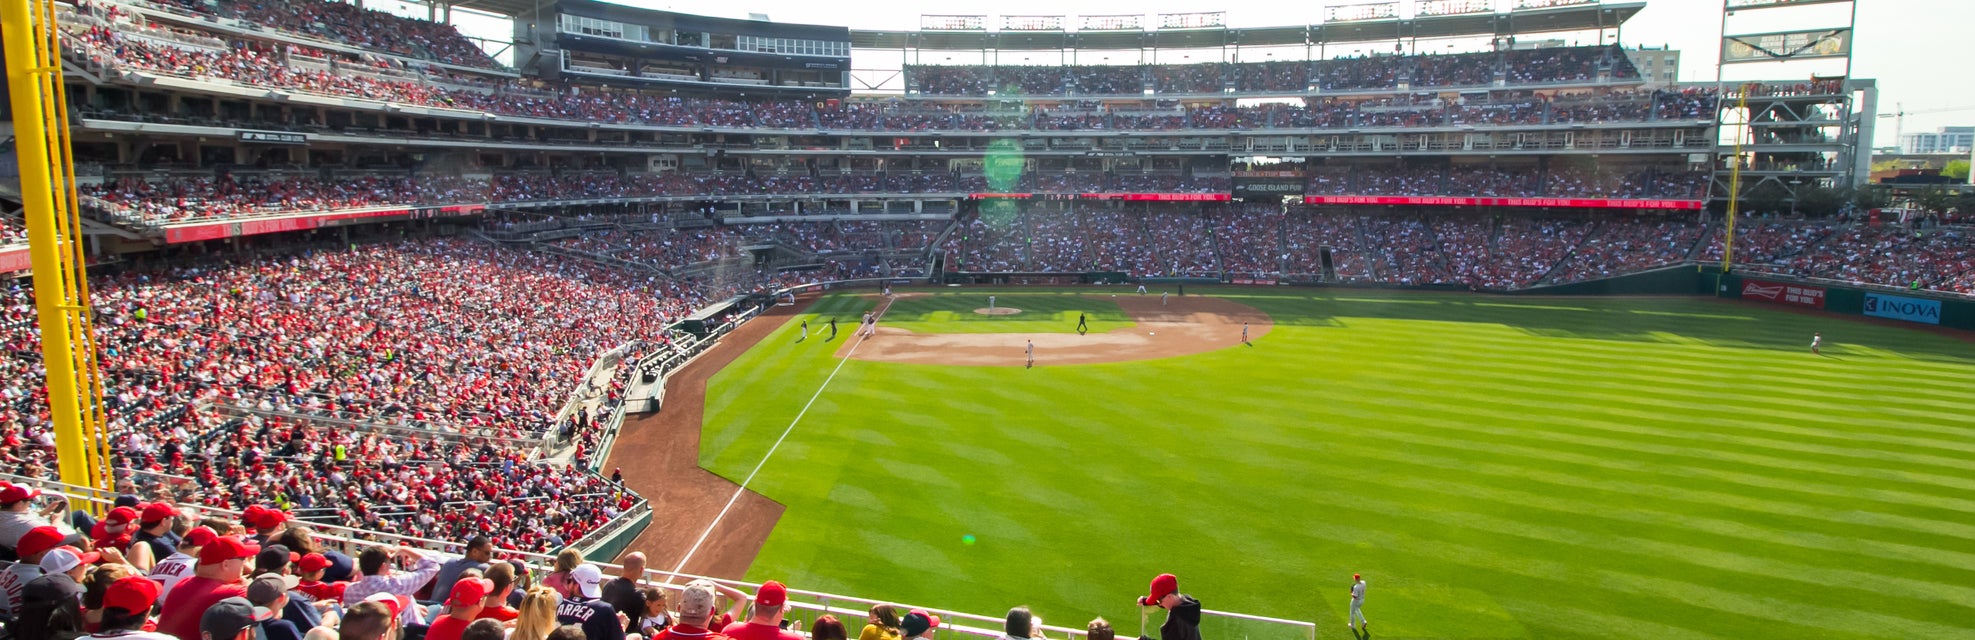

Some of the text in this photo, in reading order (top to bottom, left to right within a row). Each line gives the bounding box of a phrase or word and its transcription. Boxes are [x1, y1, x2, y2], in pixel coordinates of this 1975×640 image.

[1785, 294, 1799, 302] FOR
[1787, 286, 1802, 295] THIS
[1802, 288, 1823, 298] BUD'S
[1882, 300, 1938, 318] INOVA
